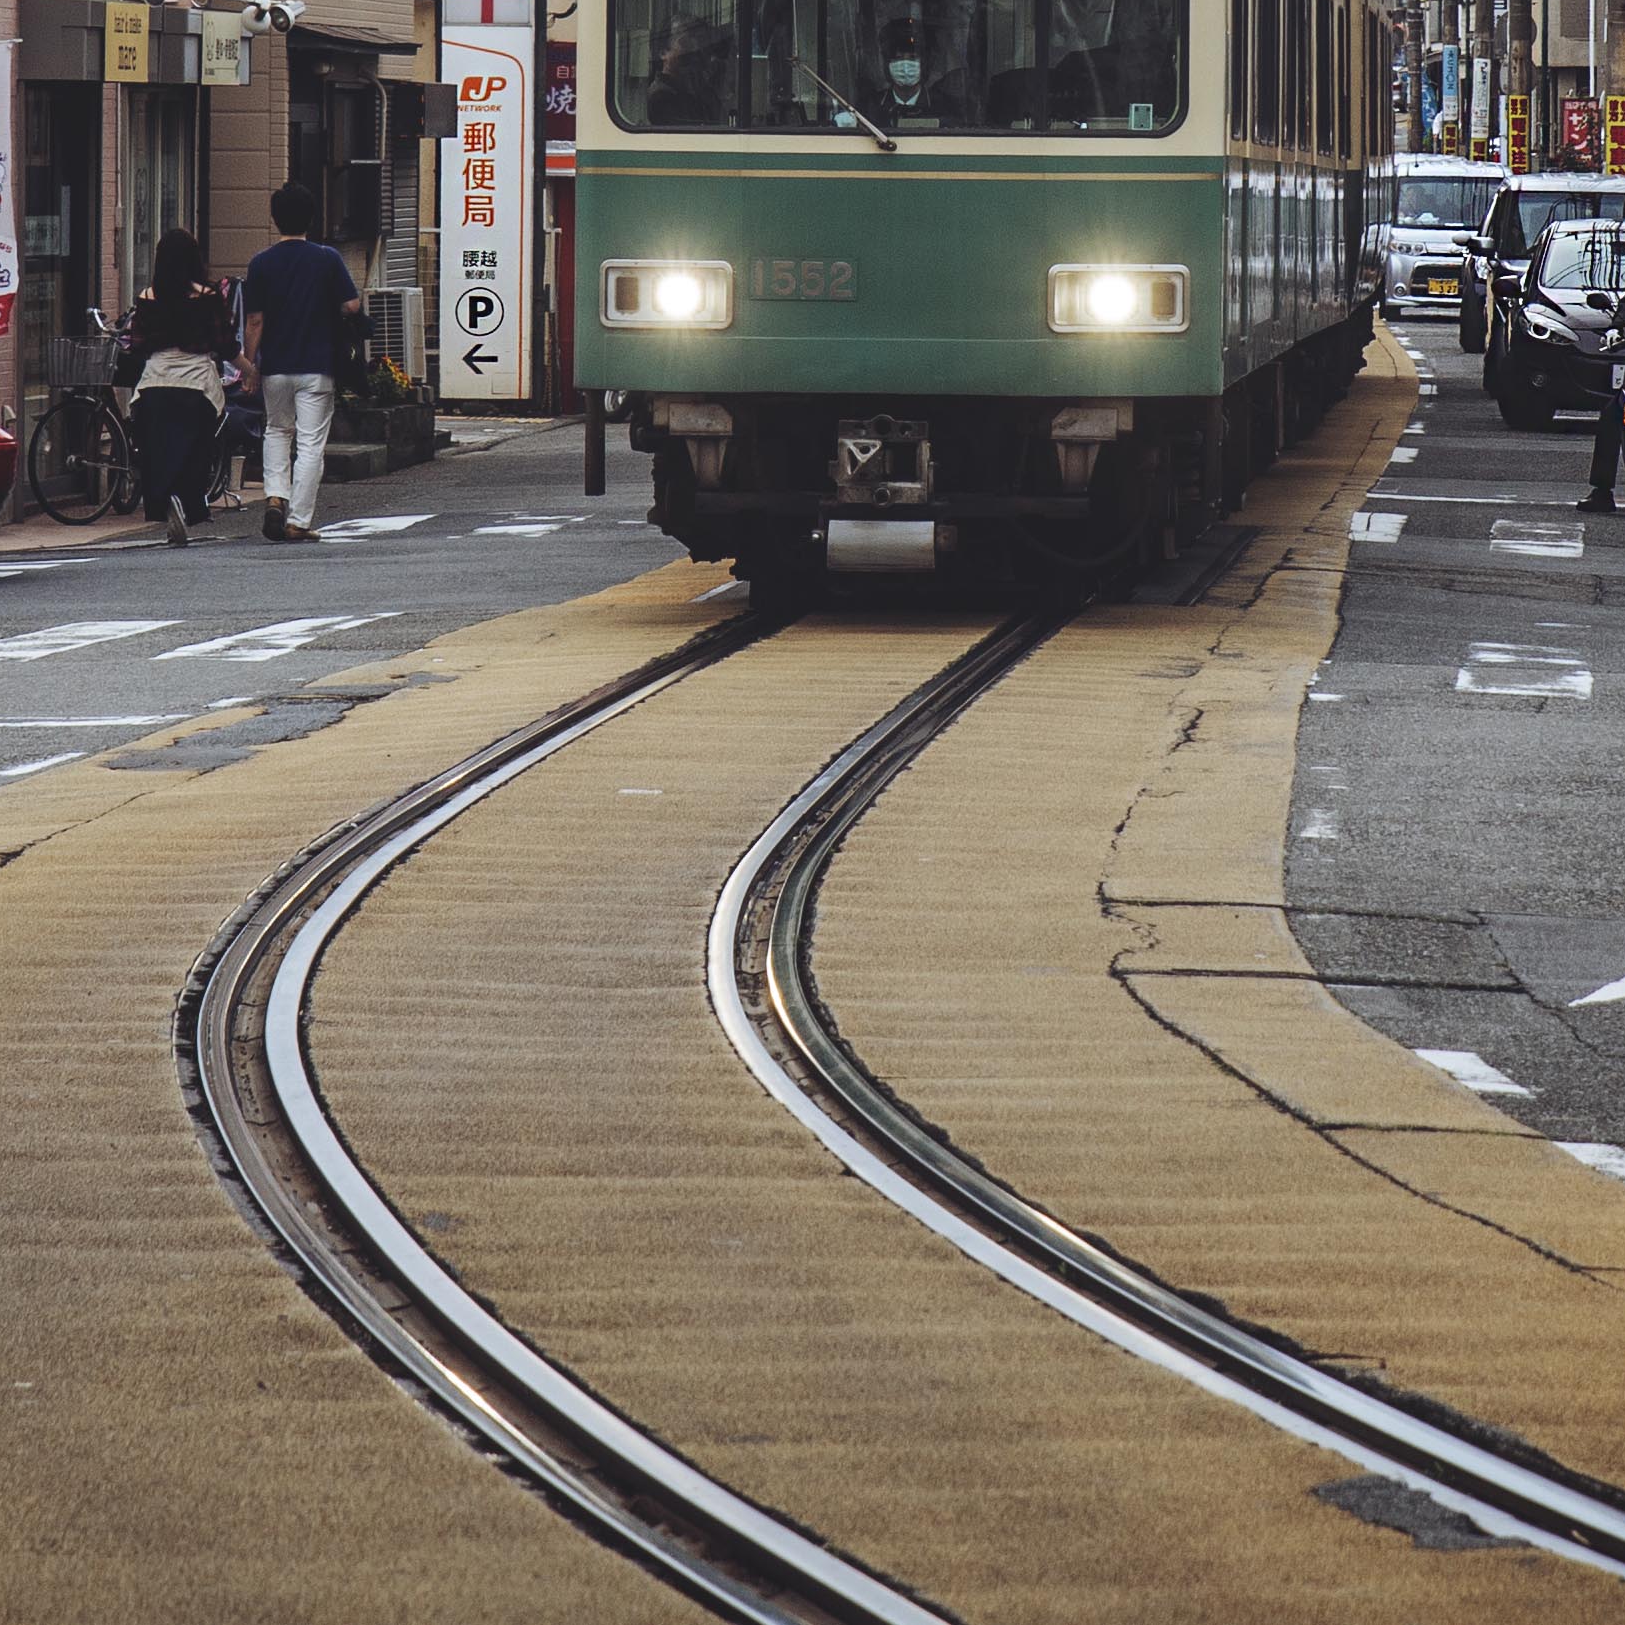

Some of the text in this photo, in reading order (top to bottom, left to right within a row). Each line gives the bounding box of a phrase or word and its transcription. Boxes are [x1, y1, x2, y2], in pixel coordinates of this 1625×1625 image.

[462, 121, 496, 227] 郵便局
[462, 250, 498, 269] 腰越
[751, 259, 853, 297] 1552
[468, 295, 495, 329] P
